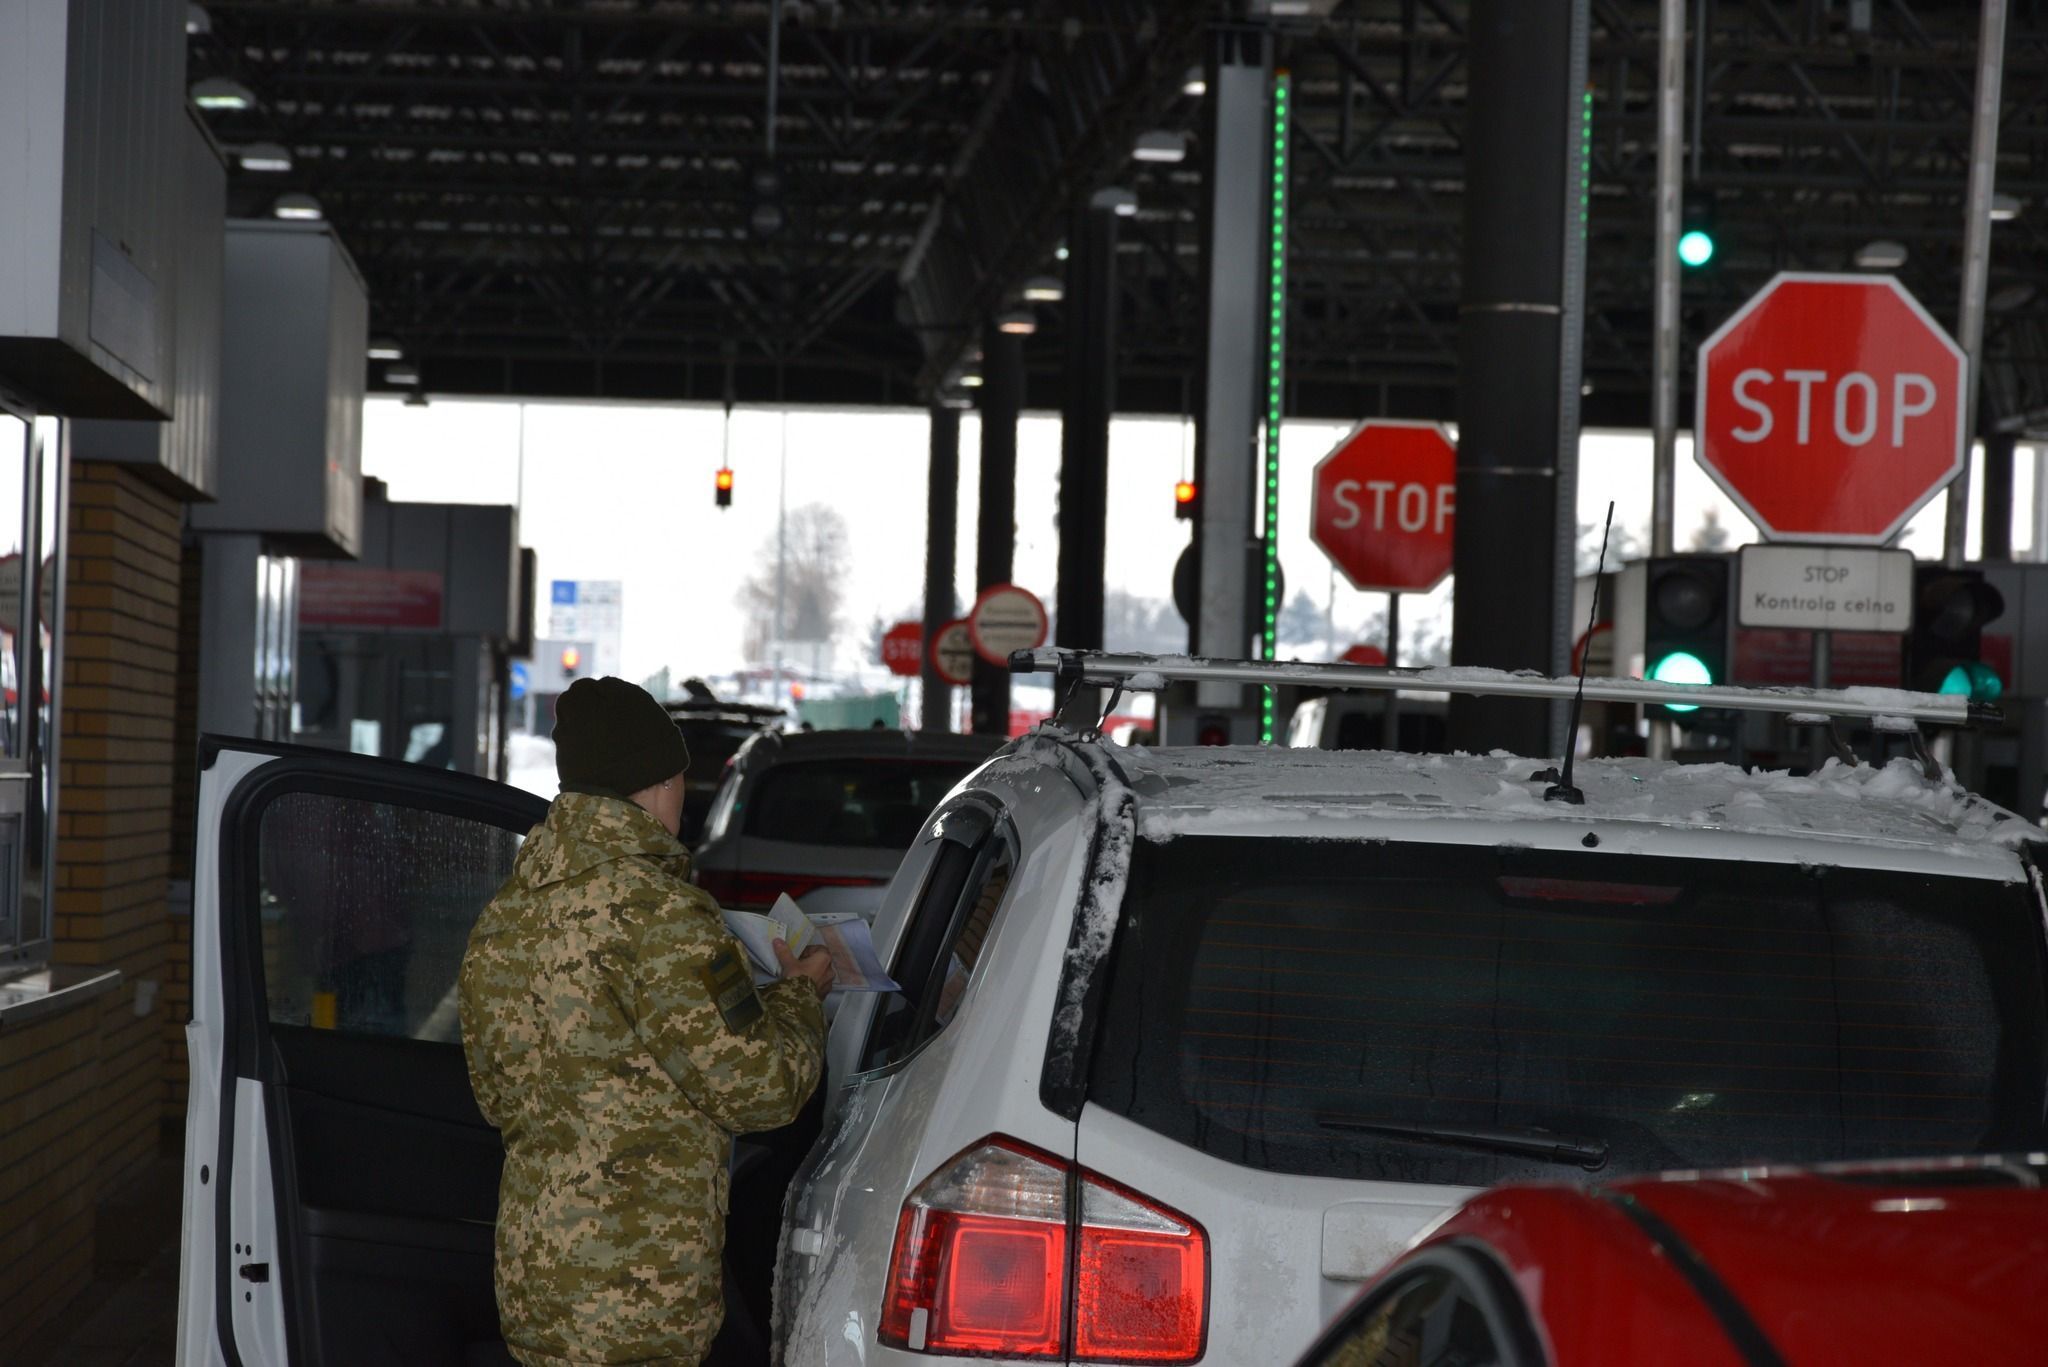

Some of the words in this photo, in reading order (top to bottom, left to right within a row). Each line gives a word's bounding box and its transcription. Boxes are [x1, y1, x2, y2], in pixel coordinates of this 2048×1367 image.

[1731, 368, 1937, 448] STOP
[1804, 565, 1849, 584] STOP
[1755, 592, 1836, 612] Kontrola
[1844, 594, 1895, 614] celna
[886, 639, 922, 660] STO
